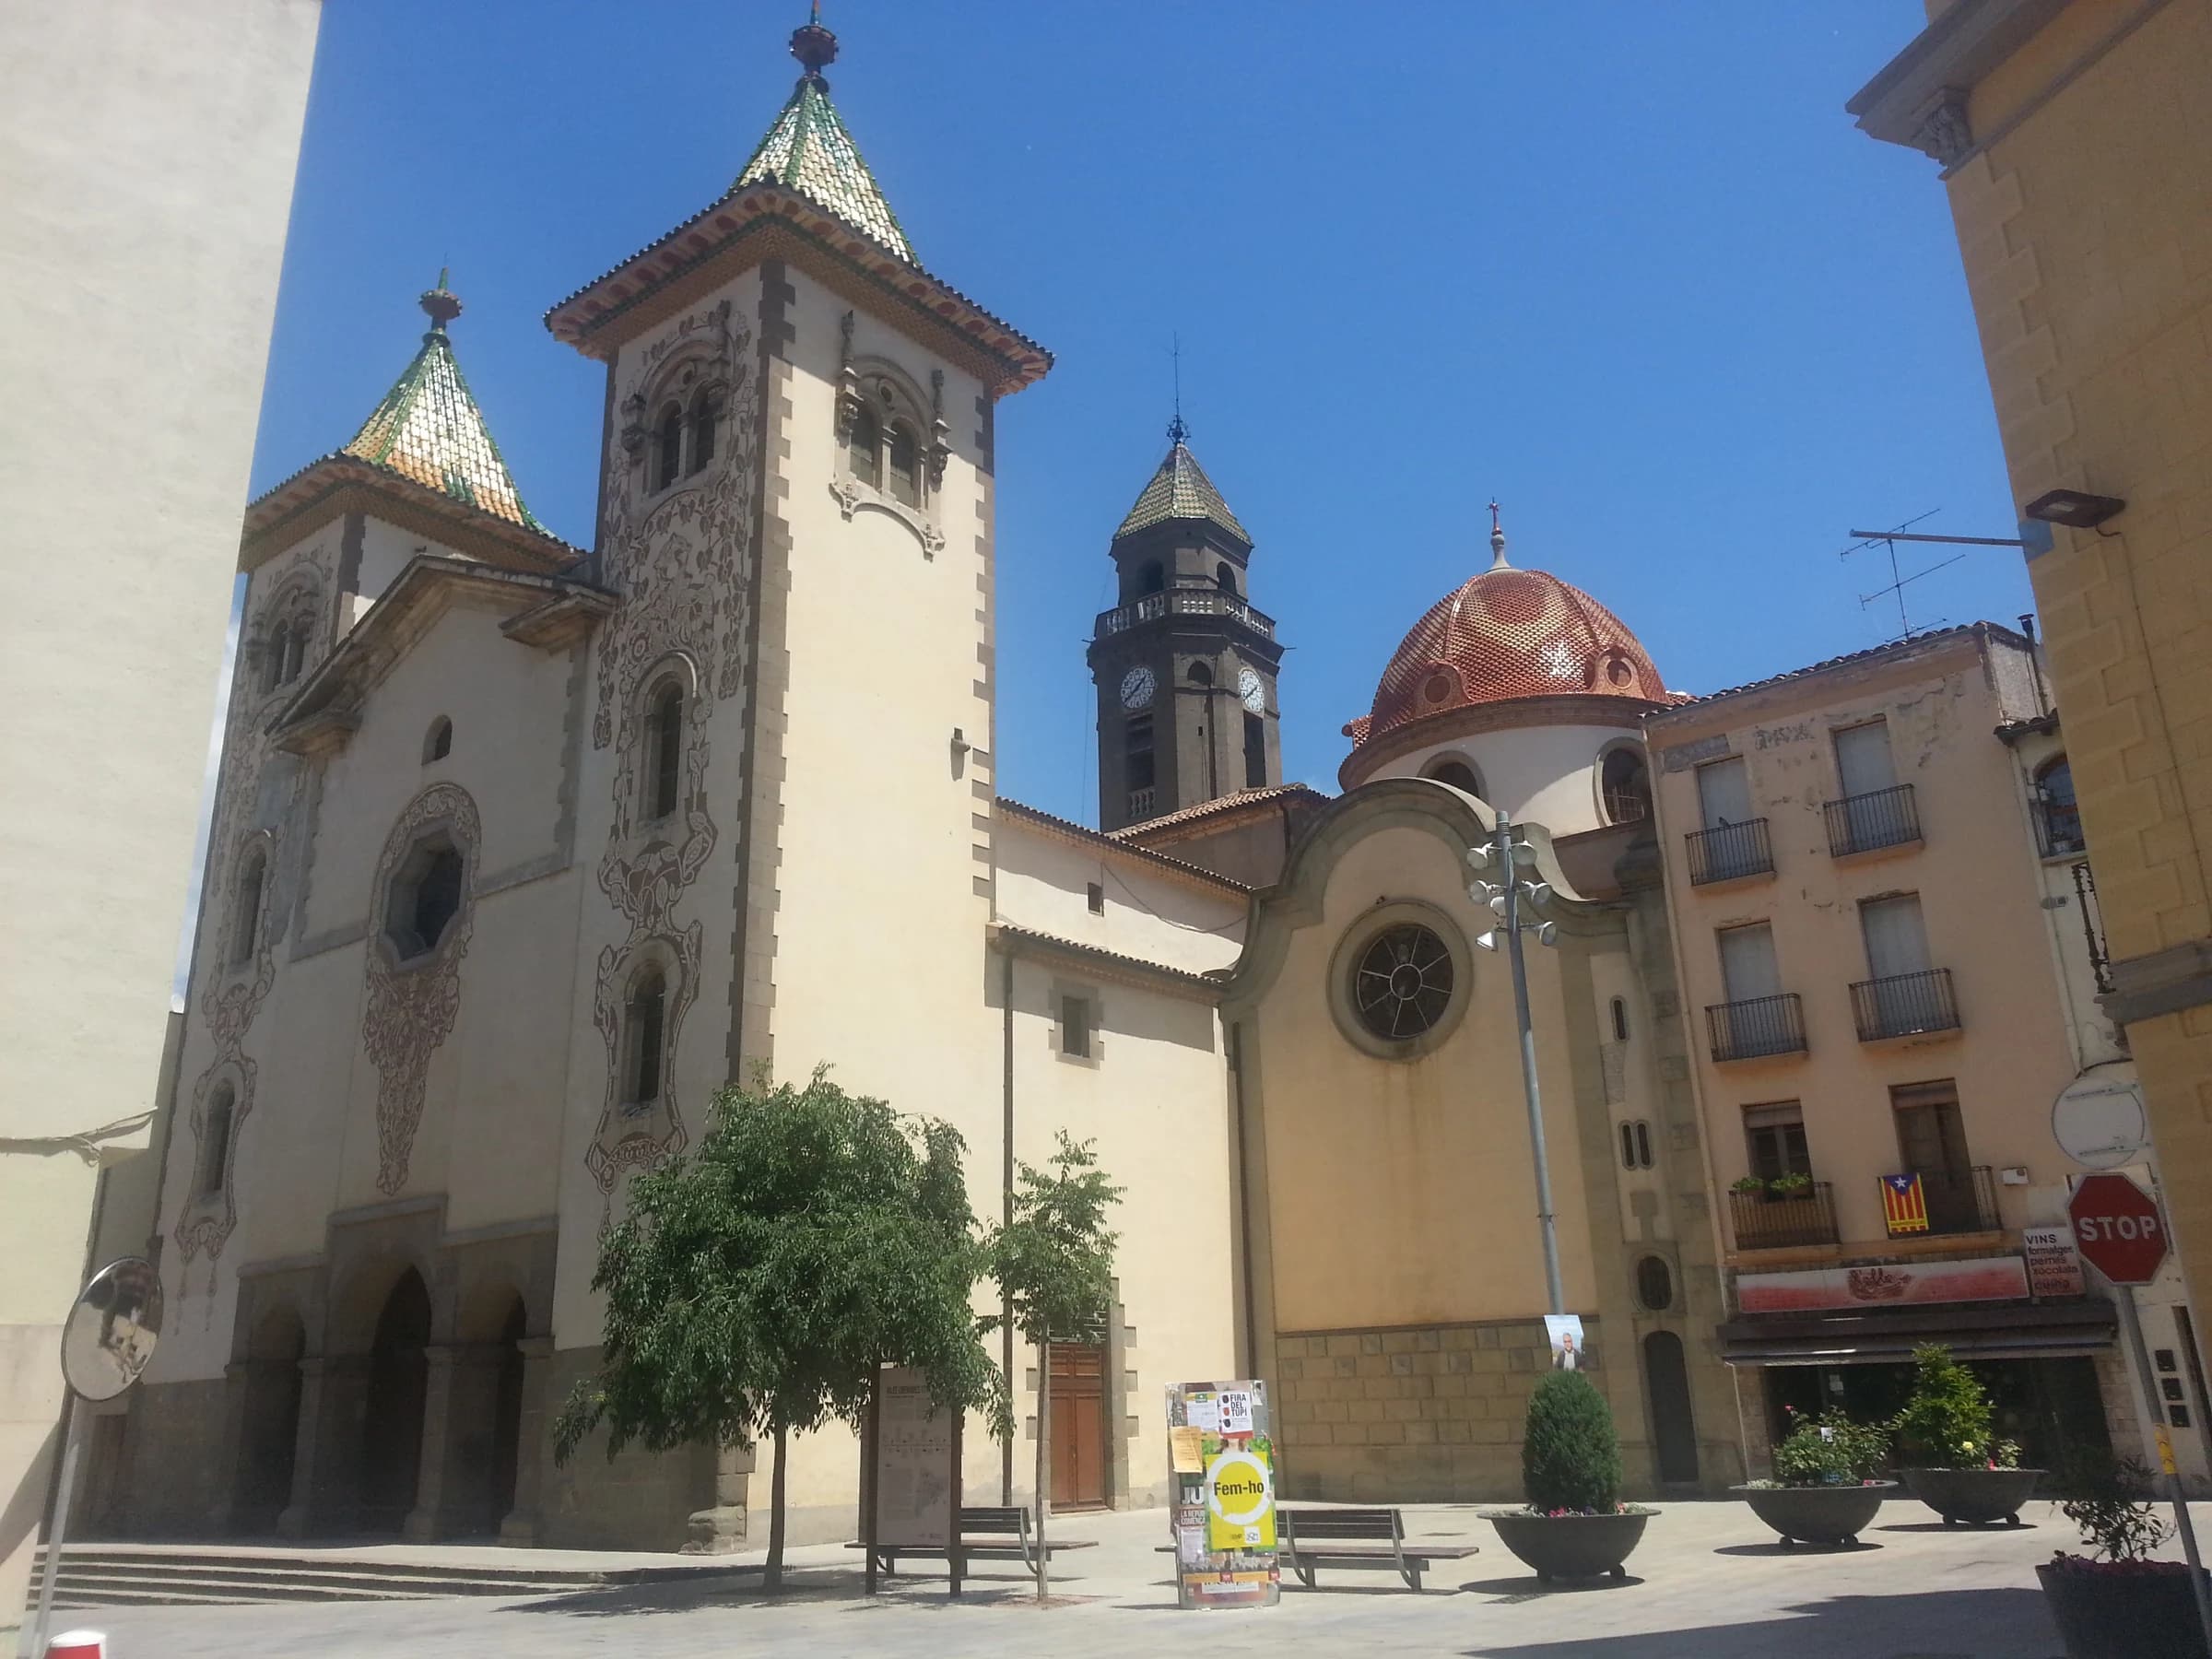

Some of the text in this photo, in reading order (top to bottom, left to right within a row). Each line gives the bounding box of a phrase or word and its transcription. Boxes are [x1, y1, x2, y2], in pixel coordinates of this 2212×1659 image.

[2079, 1216, 2156, 1241] STOP
[2026, 1234, 2056, 1244] VINS
[1230, 1394, 1246, 1402] FIRA
[1214, 1480, 1264, 1496] Fem-ho
